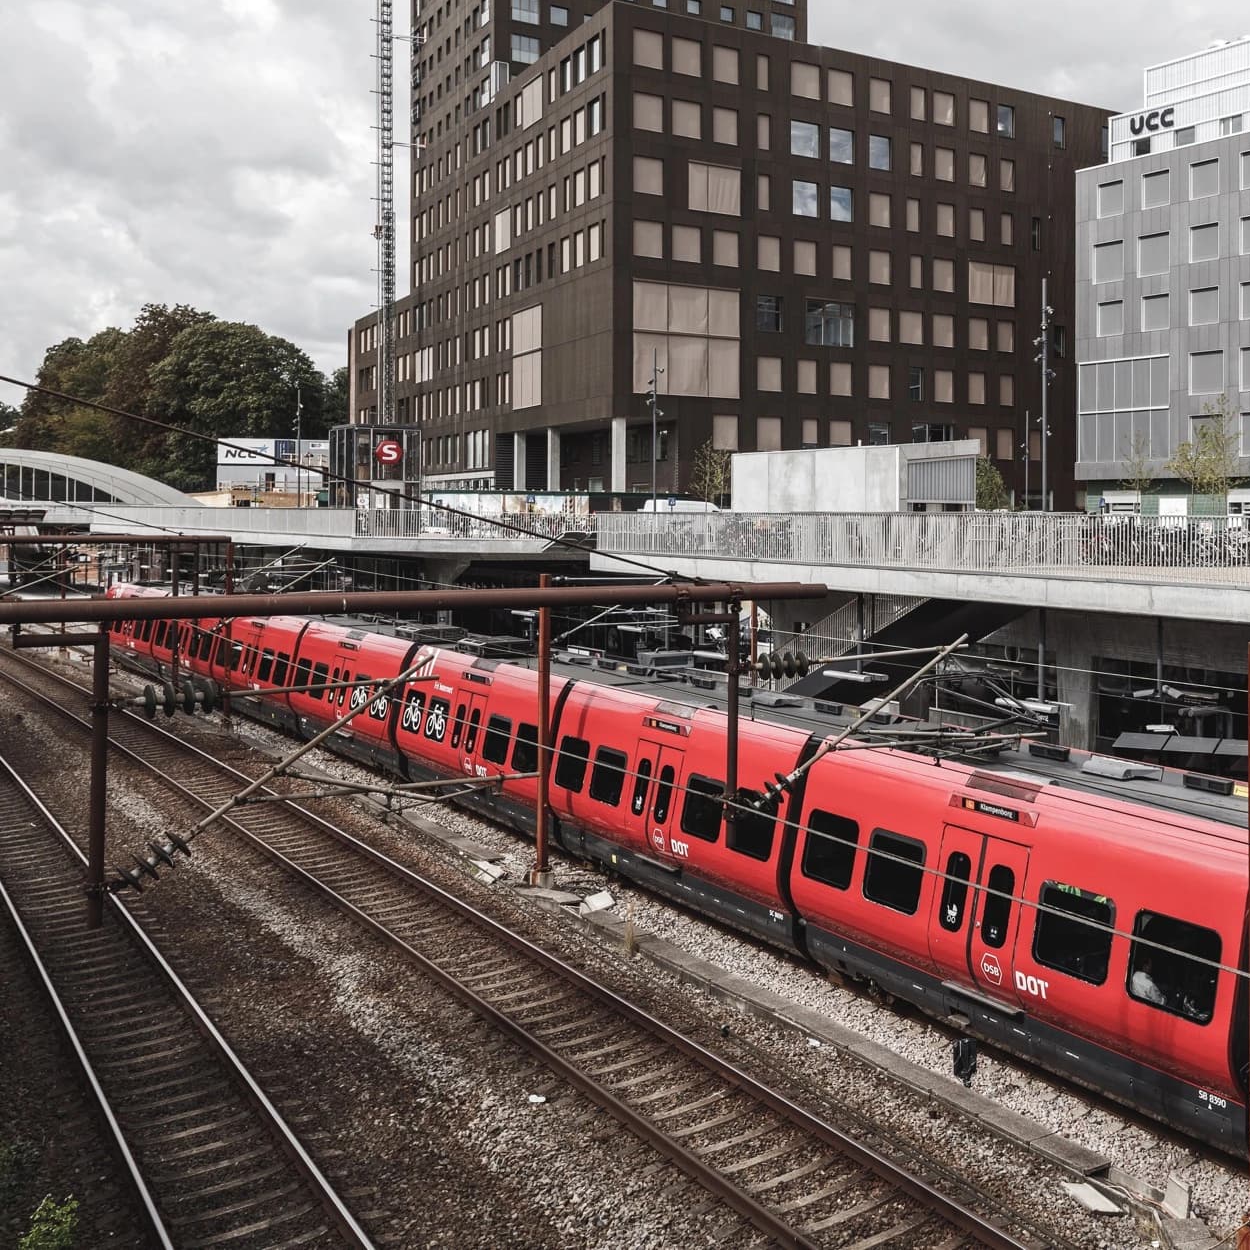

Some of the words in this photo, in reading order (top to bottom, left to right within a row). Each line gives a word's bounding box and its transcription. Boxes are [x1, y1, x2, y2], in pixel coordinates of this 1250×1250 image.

[1130, 108, 1174, 135] UCC
[225, 449, 258, 459] NCC
[382, 445, 398, 461] S
[980, 803, 1014, 819] Klampenborg
[671, 838, 689, 858] DOT
[983, 962, 1000, 977] DSB
[1015, 970, 1048, 1000] DOT
[1198, 1089, 1208, 1101] SB
[1209, 1094, 1227, 1109] 8390
